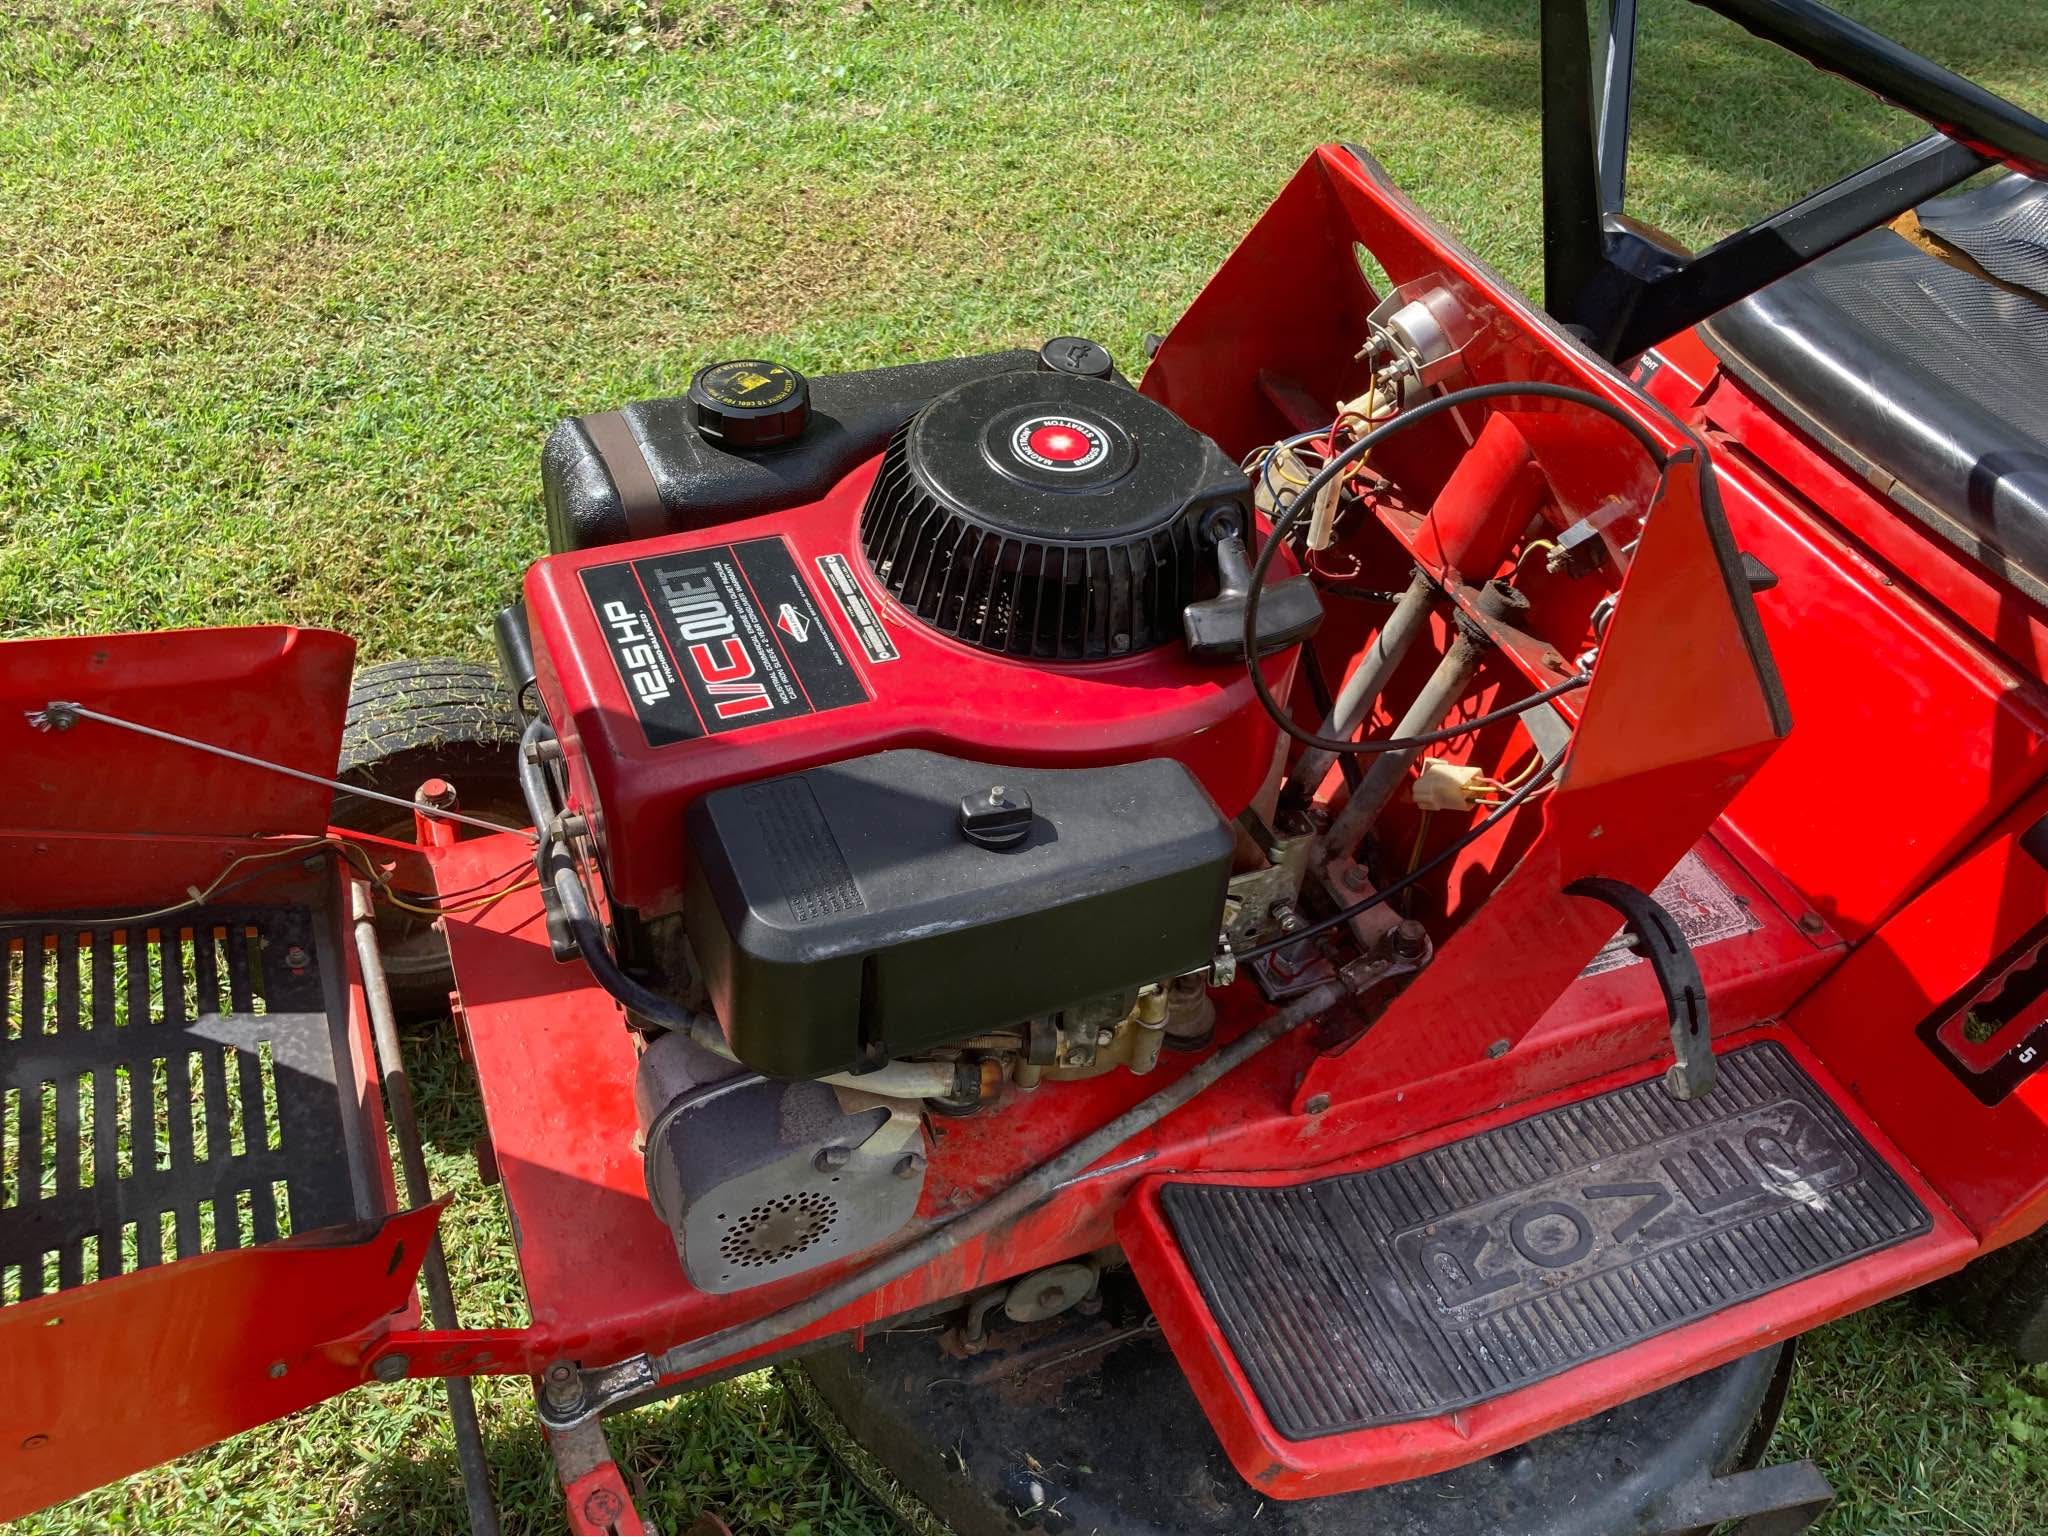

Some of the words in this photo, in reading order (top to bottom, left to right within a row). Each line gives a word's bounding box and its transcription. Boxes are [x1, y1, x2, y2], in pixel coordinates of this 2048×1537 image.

[1043, 420, 1095, 439] STRATTON
[1019, 427, 1054, 466] MAGNETRON
[1073, 447, 1100, 466] BRIGGS
[712, 560, 730, 584] PACKAGE
[722, 562, 743, 592] WARRANTY
[653, 565, 737, 642] QUIET
[724, 584, 738, 599] QUIET
[732, 599, 745, 614] WITH
[737, 592, 759, 623] CONSUMER
[603, 600, 646, 644] HP
[739, 613, 755, 634] ENGINE
[639, 611, 676, 684] SYNCHRO-BALANCED
[749, 633, 774, 671] COMMERCIAL
[765, 646, 782, 668] SLEEVE
[621, 647, 671, 706] 12.5
[767, 670, 791, 704] INDUSTRIAL
[775, 667, 790, 683] IRON
[783, 682, 798, 699] CAST
[2018, 1046, 2037, 1064] 5
[1420, 1113, 1856, 1308] ROVER
